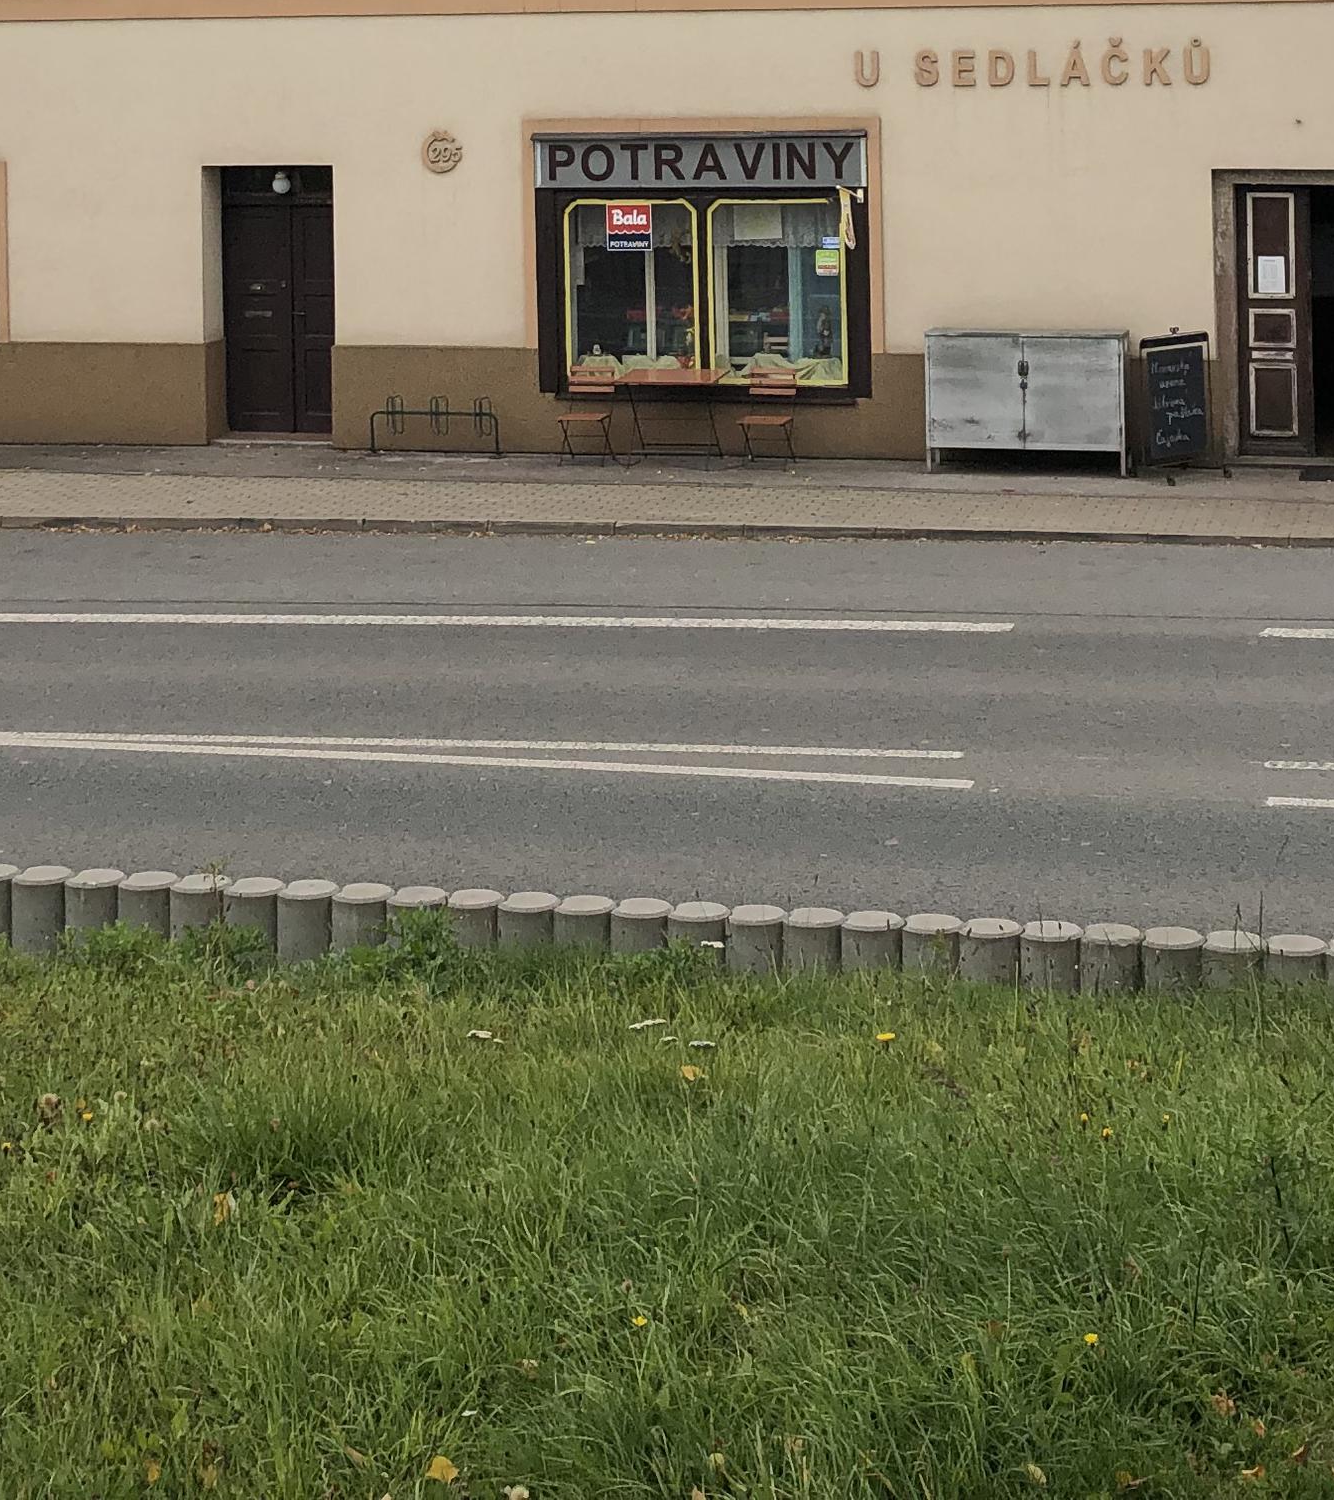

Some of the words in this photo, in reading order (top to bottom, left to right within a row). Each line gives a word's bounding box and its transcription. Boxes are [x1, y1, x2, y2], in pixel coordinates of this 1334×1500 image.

[853, 50, 880, 87] U
[914, 36, 1211, 87] SEDLÁČKŮ
[548, 142, 855, 181] POTRAVINY
[611, 209, 648, 225] Bala
[610, 240, 650, 248] POTRAVINY
